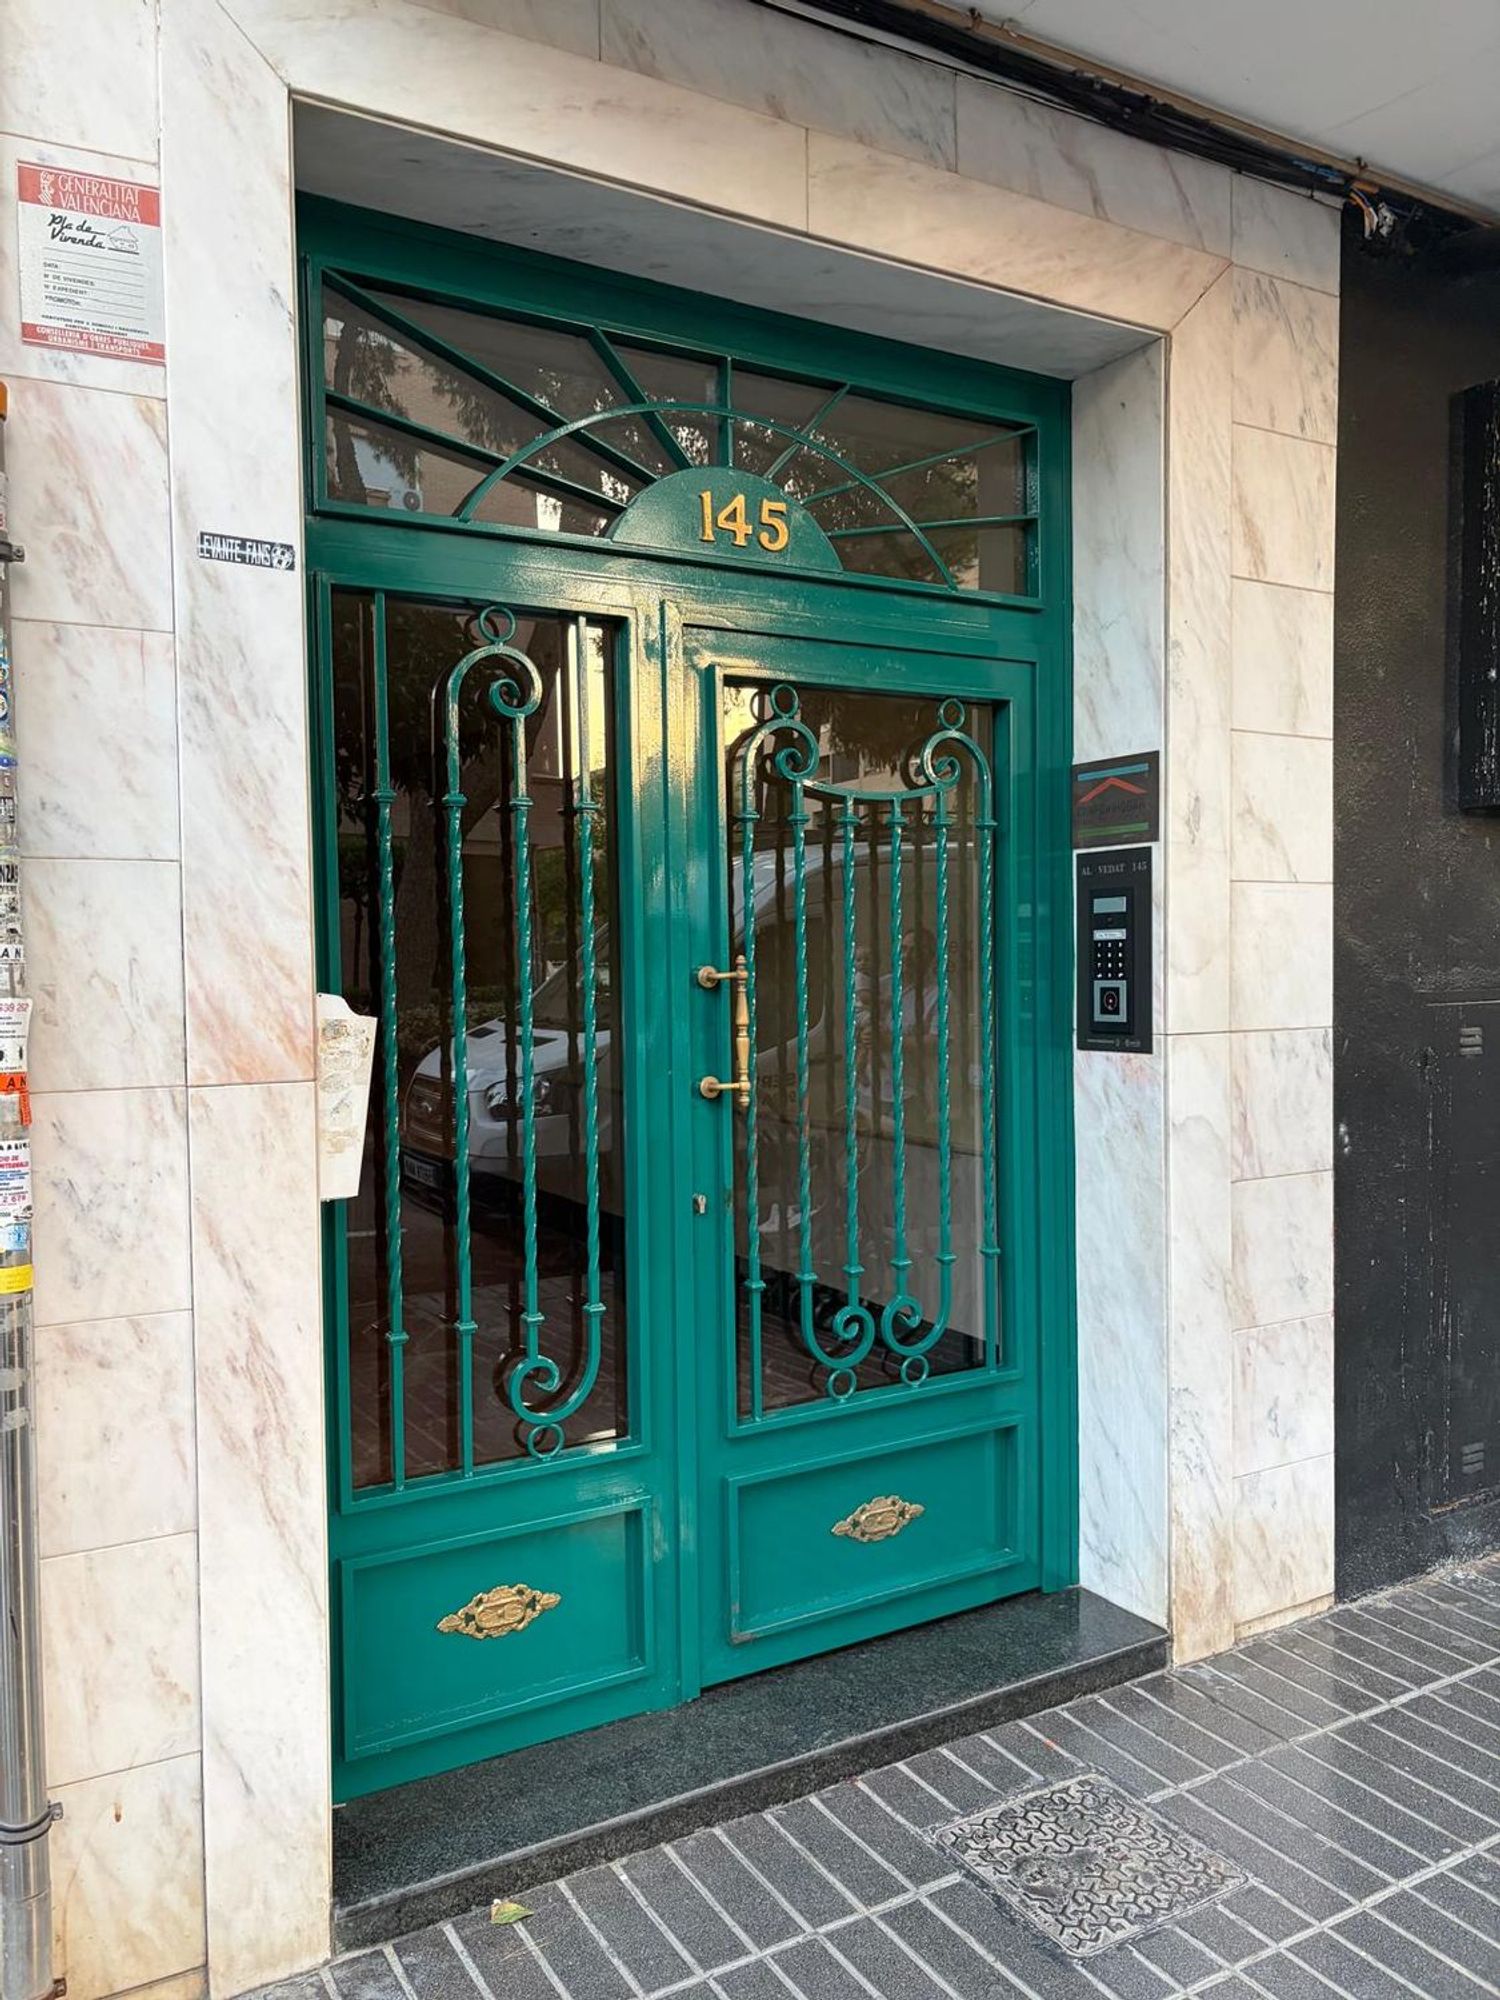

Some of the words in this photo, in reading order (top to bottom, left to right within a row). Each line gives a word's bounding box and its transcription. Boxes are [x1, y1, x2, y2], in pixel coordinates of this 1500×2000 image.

[58, 174, 139, 205] GENERALITAT
[59, 192, 141, 222] VALENCIANA
[47, 213, 74, 234] Pla
[75, 220, 94, 234] de
[50, 227, 105, 249] Vivenda
[700, 490, 789, 551] 145
